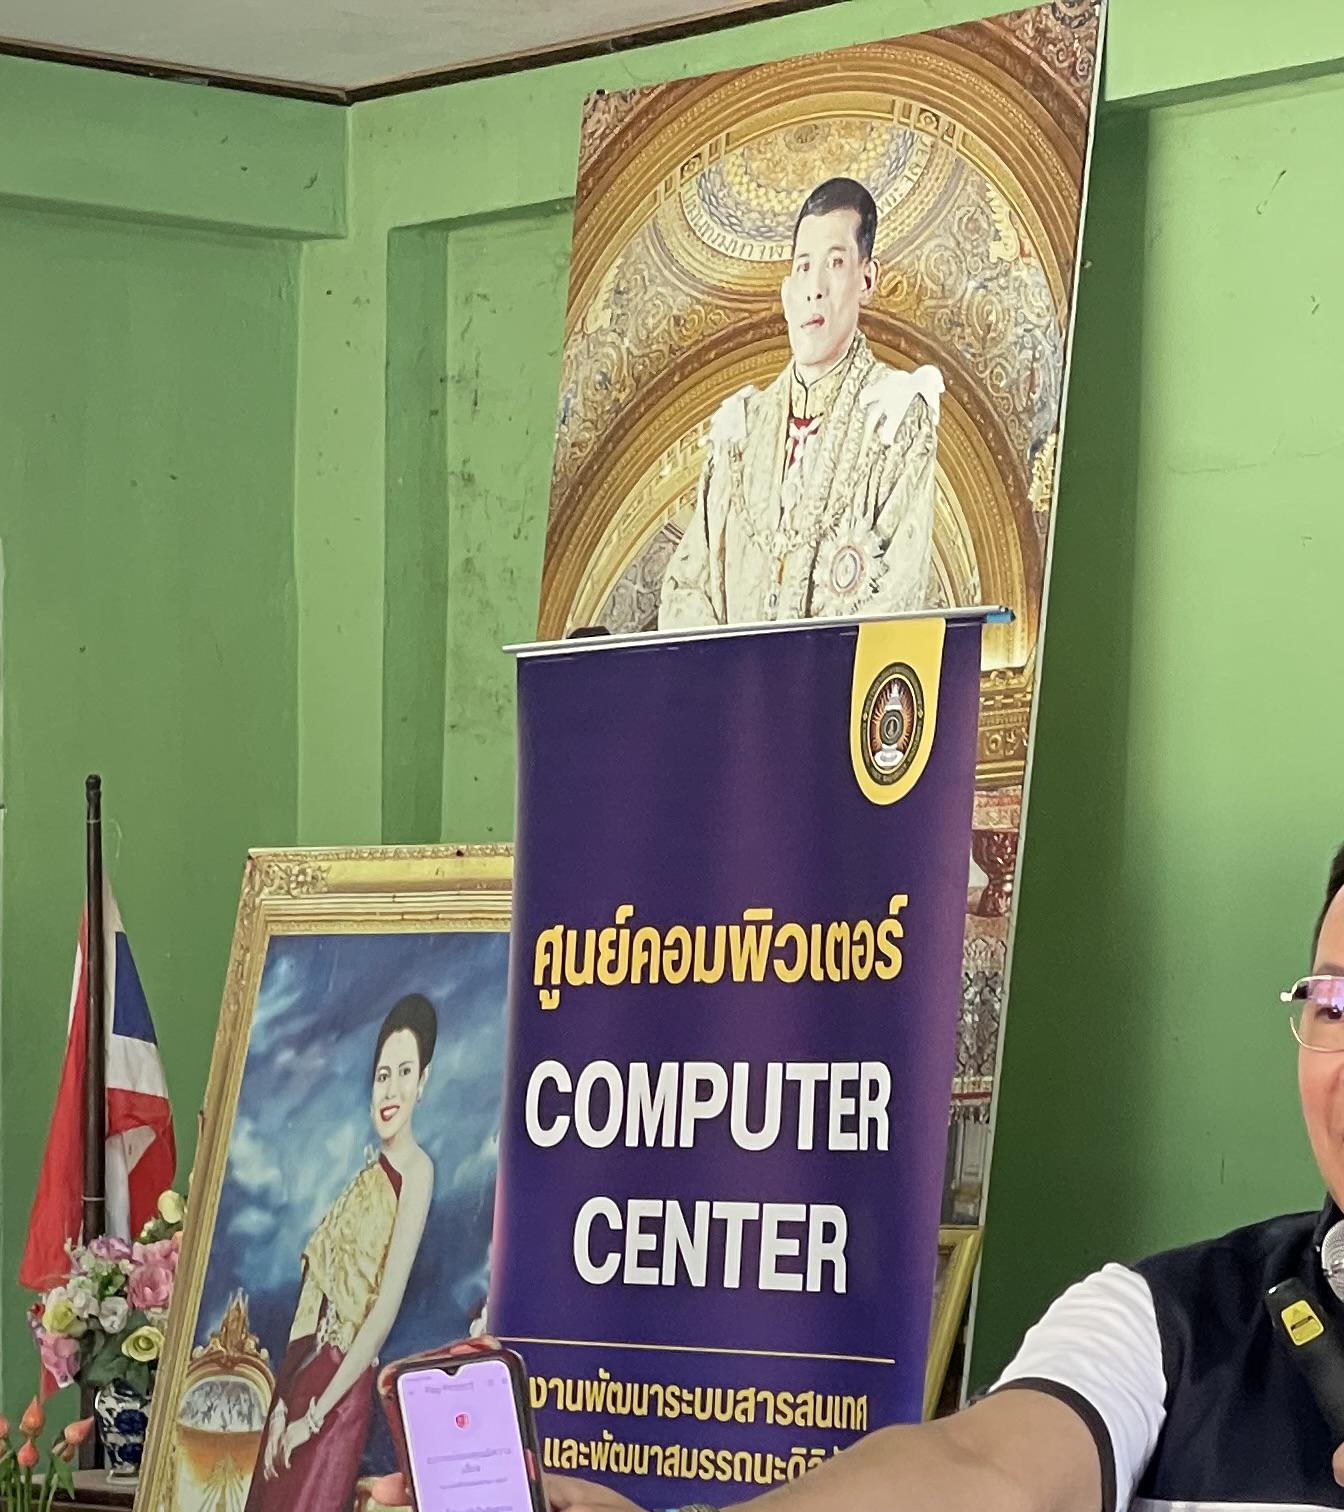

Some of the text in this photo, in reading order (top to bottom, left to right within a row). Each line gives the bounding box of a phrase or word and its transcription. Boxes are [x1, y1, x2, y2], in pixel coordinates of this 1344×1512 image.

[533, 895, 908, 1009] ศูนย์คอมพิวเตอร์
[524, 1060, 892, 1152] COMPUTER
[572, 1196, 848, 1294] CENTER
[528, 1367, 868, 1432] งานพัฒนาระบบสารสนเทศ
